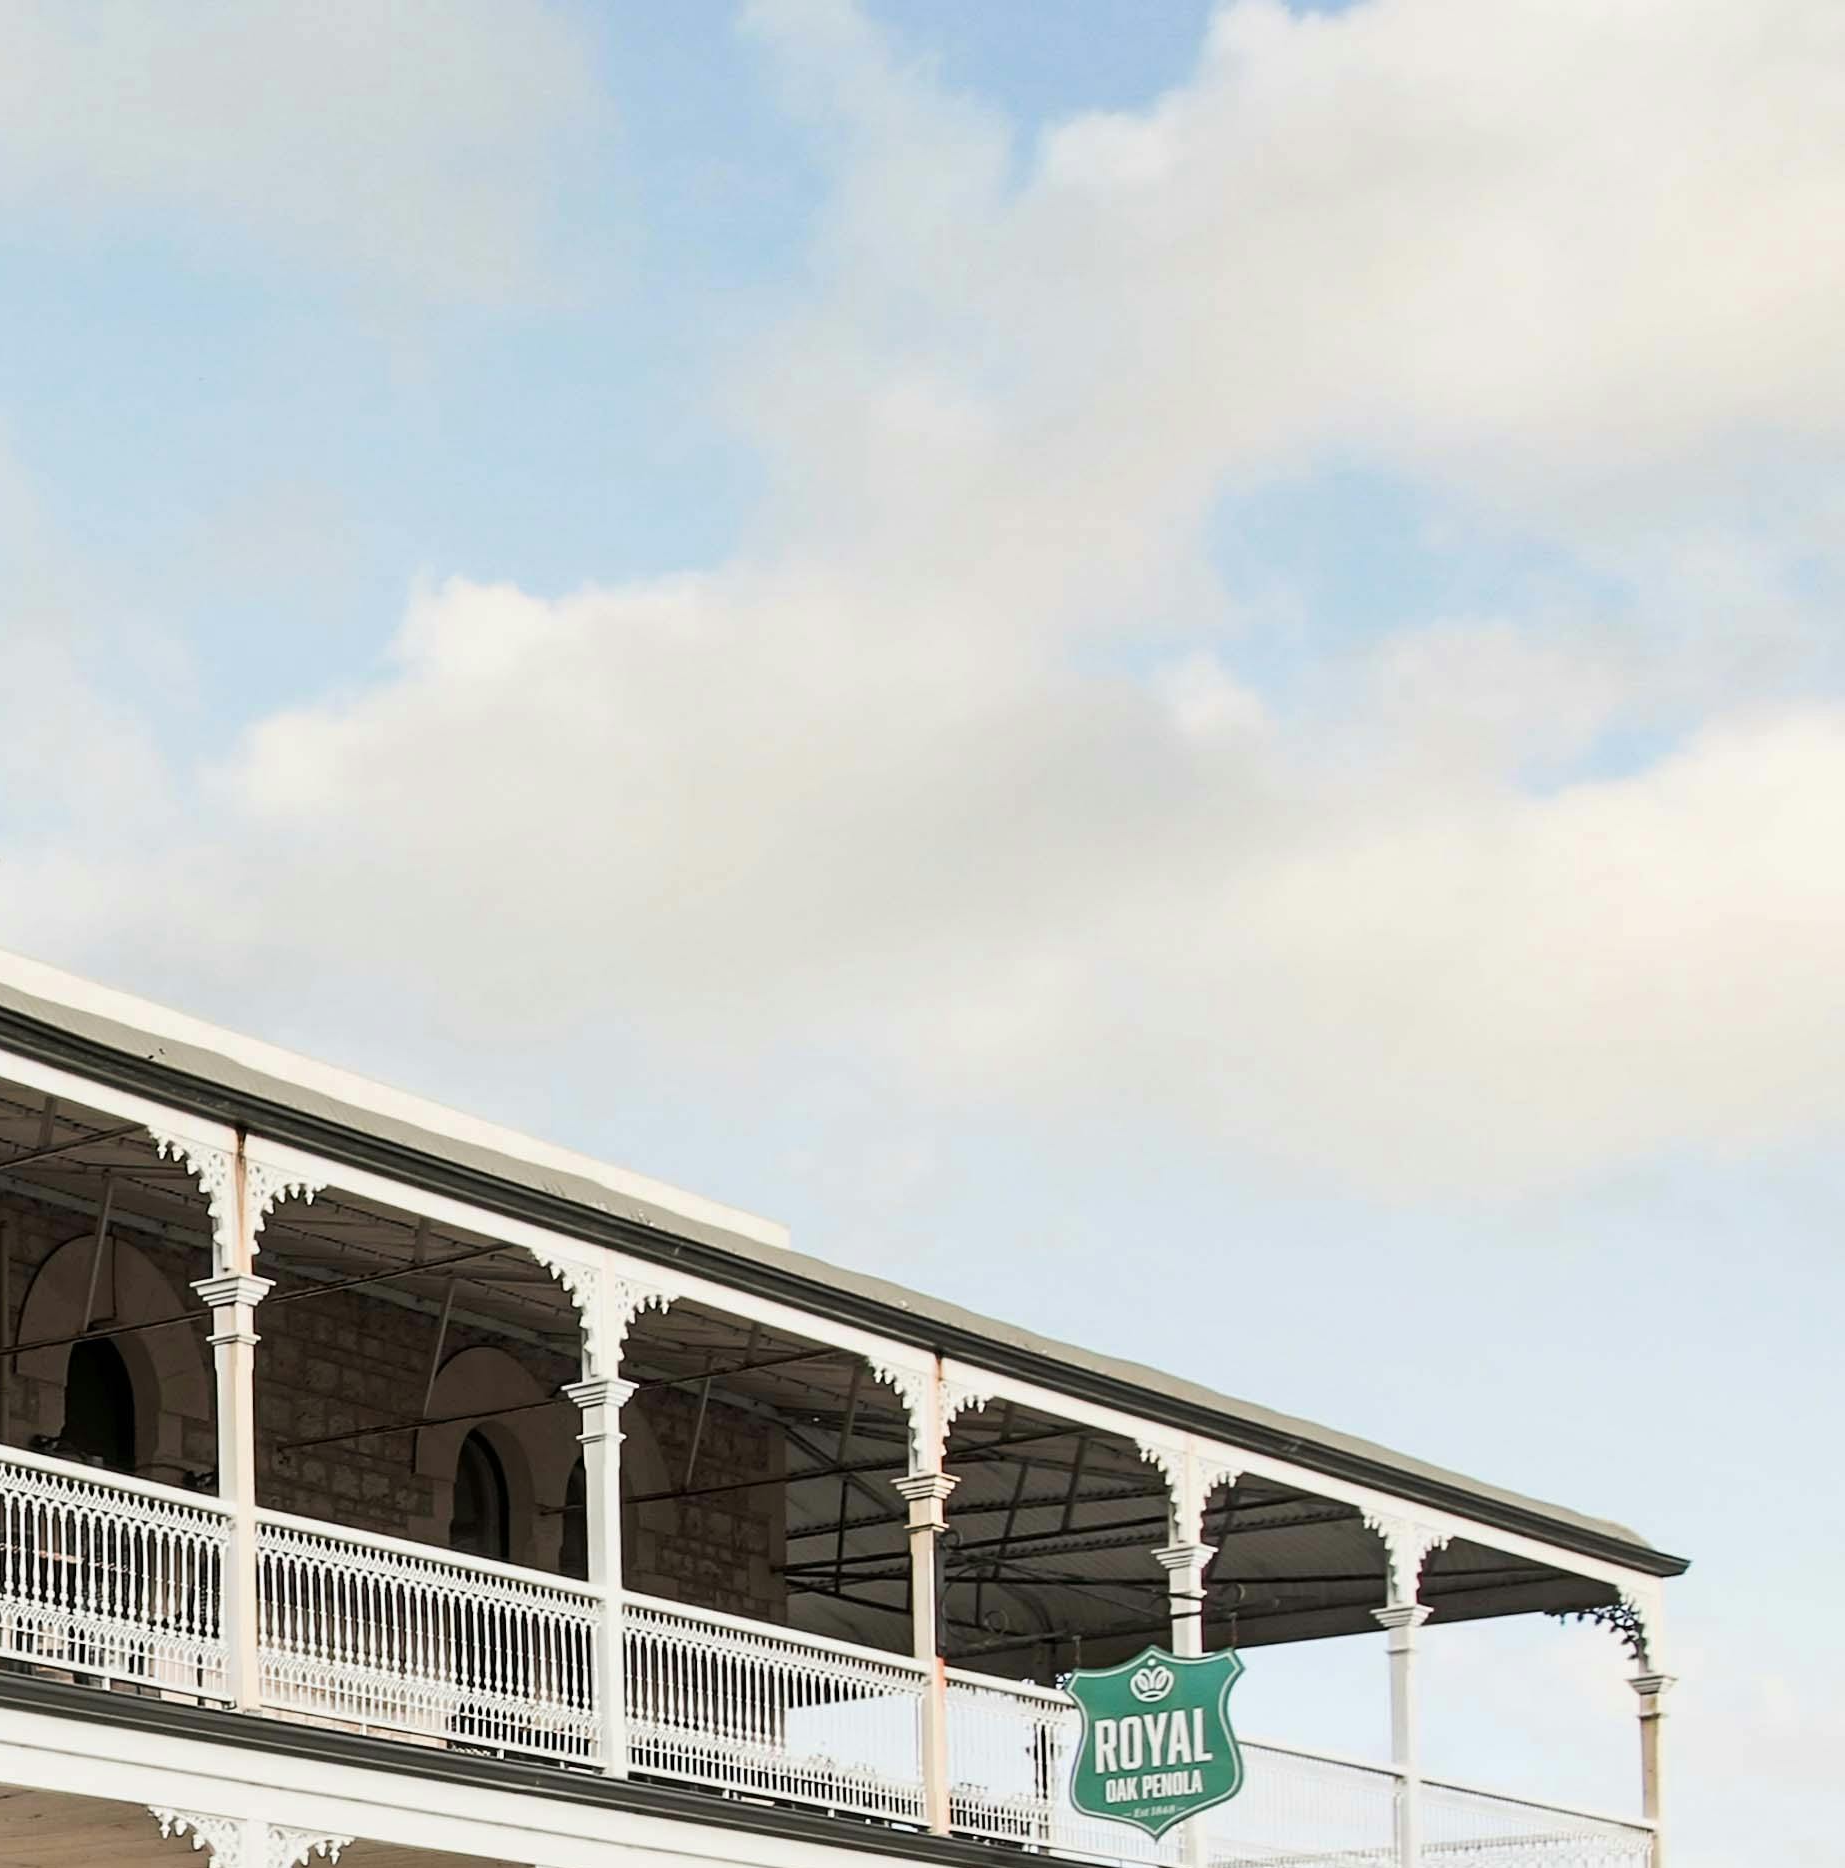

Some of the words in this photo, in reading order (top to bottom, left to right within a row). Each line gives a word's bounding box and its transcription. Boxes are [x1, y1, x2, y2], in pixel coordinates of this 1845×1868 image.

[1094, 1707, 1214, 1774] ROYAL
[1105, 1776, 1139, 1804] OAK
[1142, 1769, 1204, 1799] PENOLA
